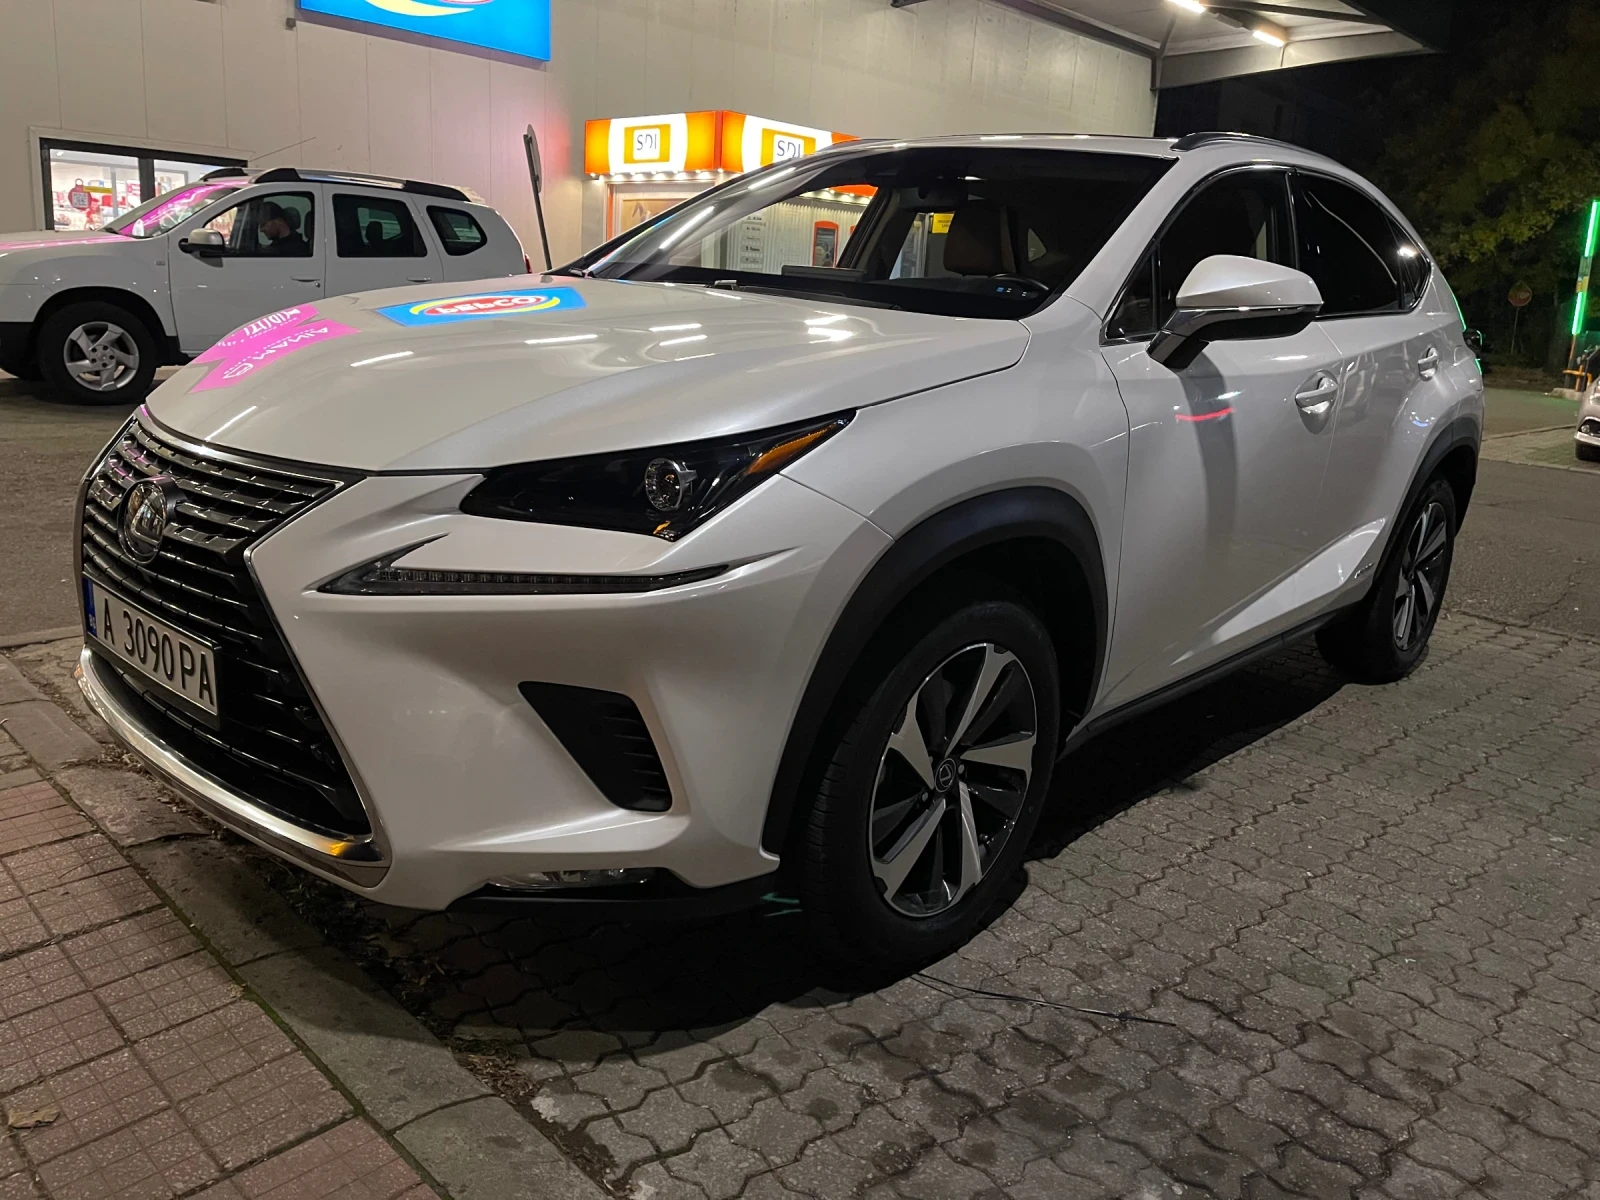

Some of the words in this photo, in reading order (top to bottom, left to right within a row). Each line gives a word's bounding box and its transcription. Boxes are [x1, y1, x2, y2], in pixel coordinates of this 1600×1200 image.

[636, 133, 658, 151] SDI
[776, 139, 801, 159] SDI
[103, 597, 116, 646] A
